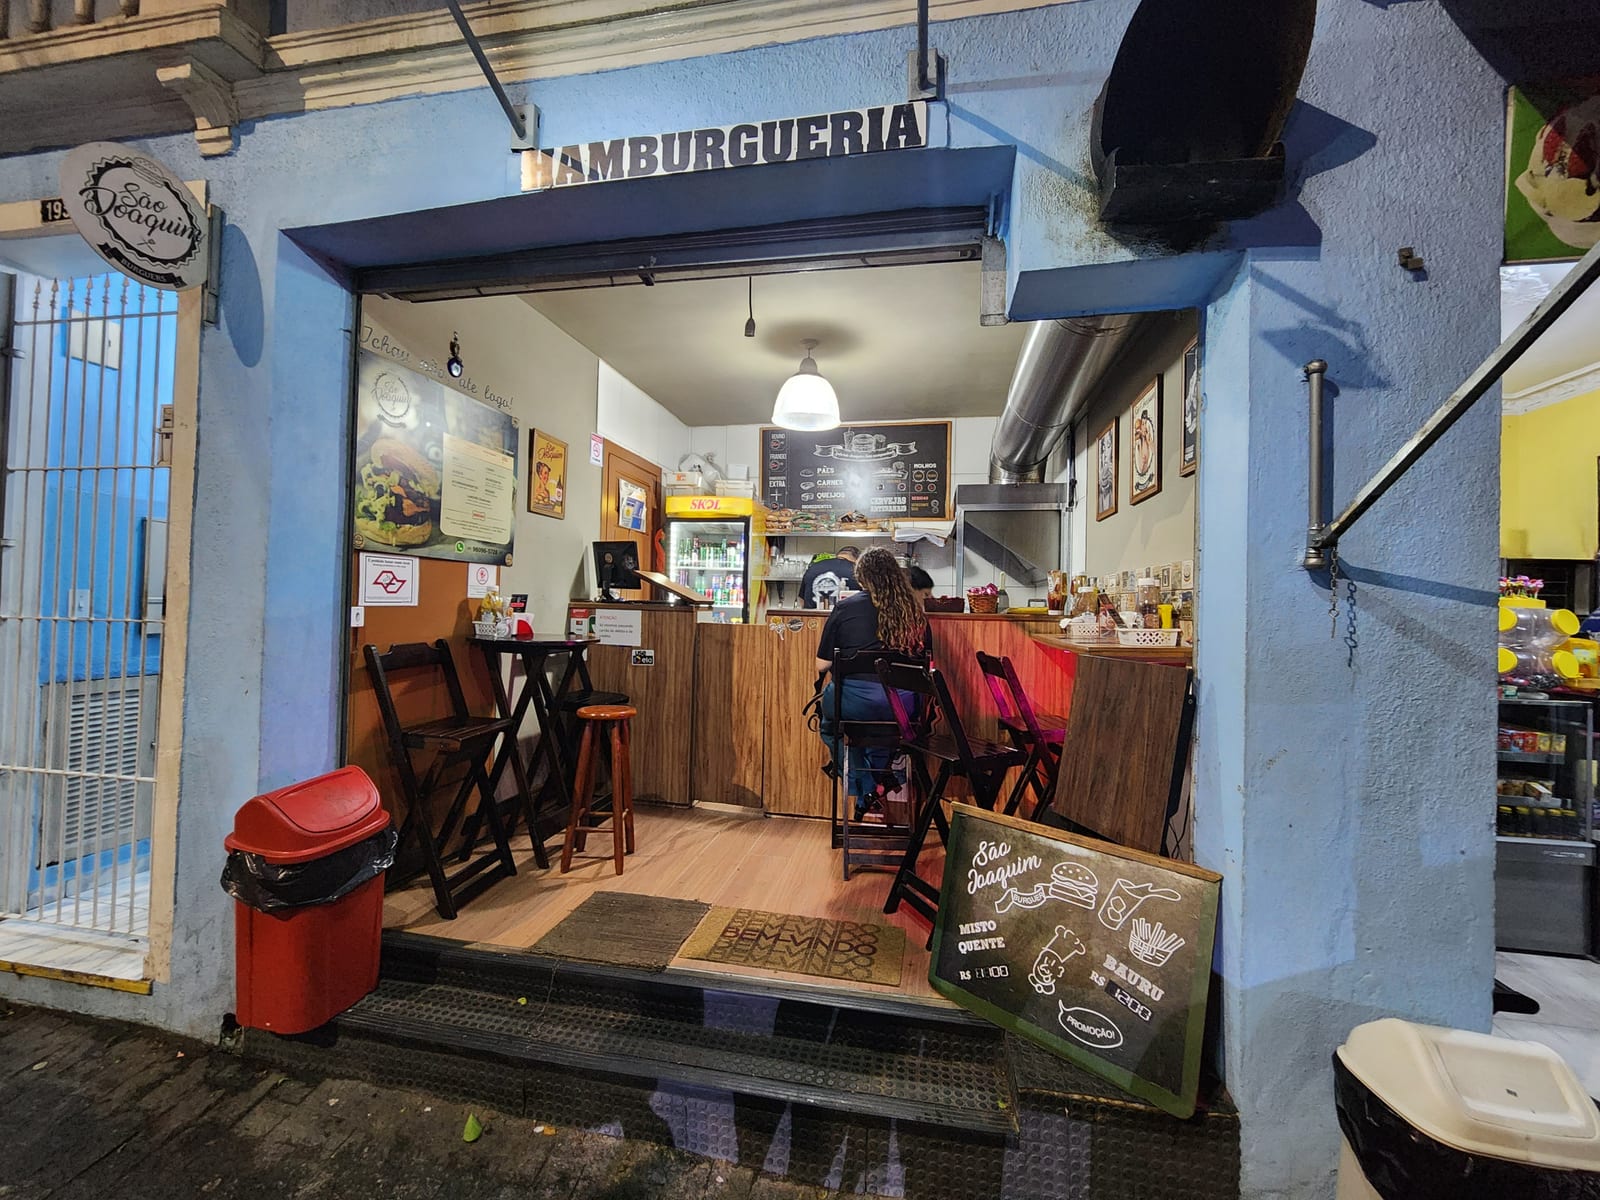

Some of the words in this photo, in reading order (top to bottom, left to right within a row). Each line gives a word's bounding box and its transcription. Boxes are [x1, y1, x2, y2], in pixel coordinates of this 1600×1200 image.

[522, 103, 922, 190] HAMBURGUERIA
[118, 182, 168, 213] São
[79, 186, 204, 242] Joaquim
[690, 499, 720, 510] SKOL
[972, 841, 1012, 868] São
[967, 855, 1042, 895] Joaquim
[959, 920, 997, 935] MISTO
[958, 937, 1006, 954] QUENTE
[1102, 954, 1165, 1002] BAURU
